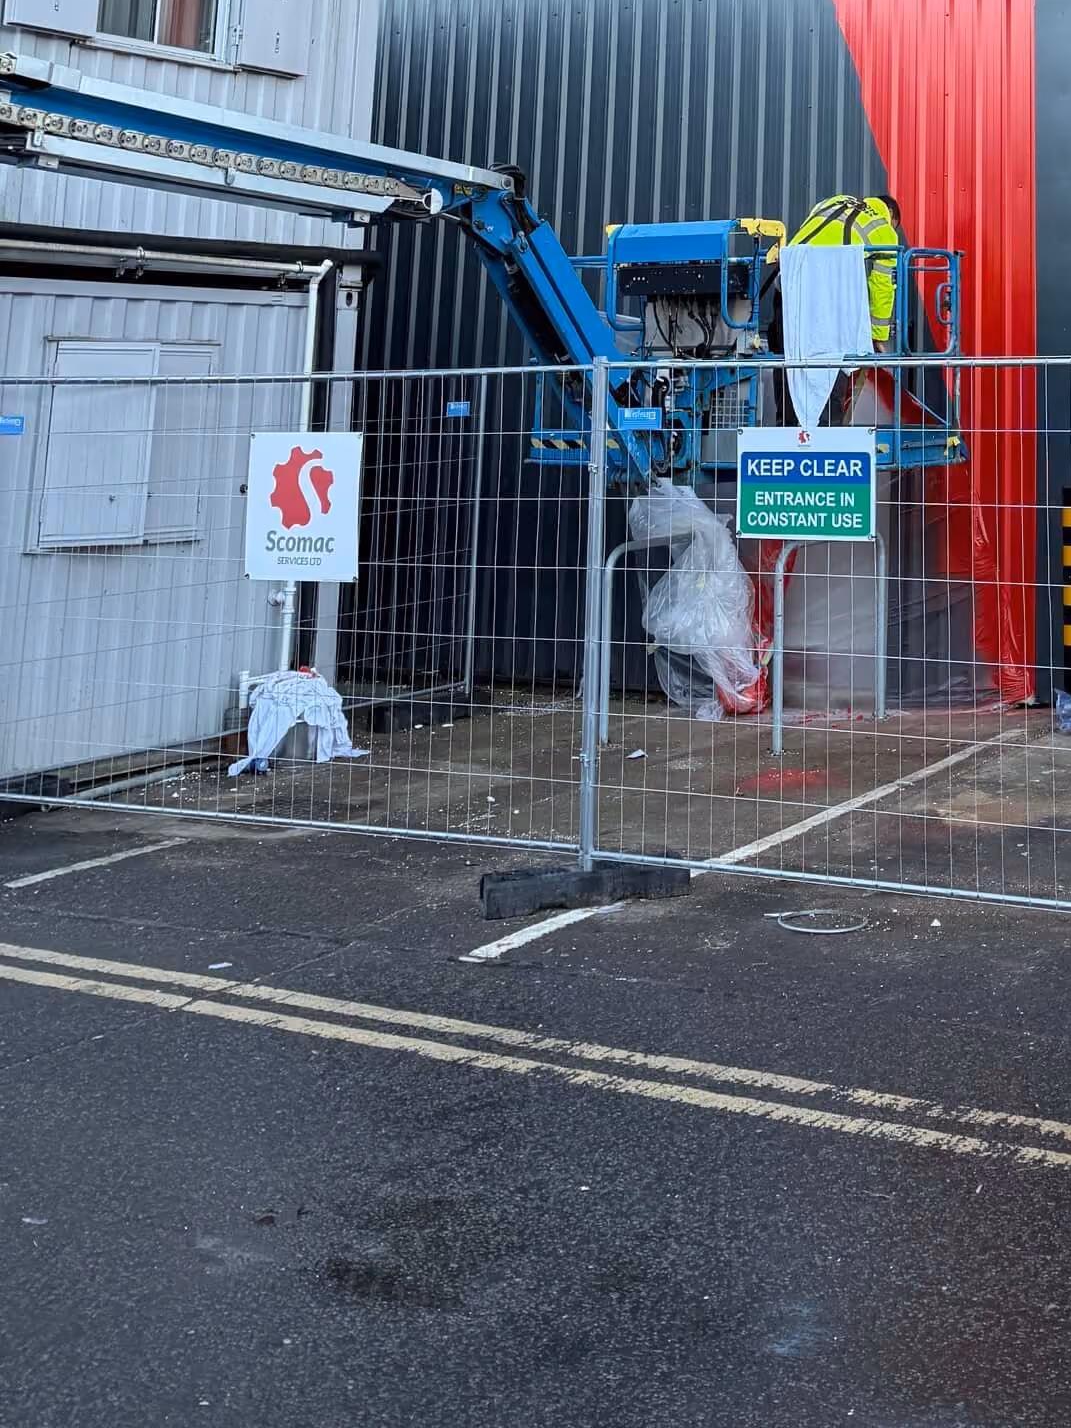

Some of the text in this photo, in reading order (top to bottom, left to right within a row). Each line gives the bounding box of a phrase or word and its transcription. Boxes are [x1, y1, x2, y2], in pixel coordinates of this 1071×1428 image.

[747, 459, 863, 477] KEEP CLEAR
[755, 491, 855, 507] ENTRANCE IN
[747, 511, 863, 528] CONSTANT USE
[265, 530, 335, 553] Scomac
[277, 556, 322, 566] SERVICES LTD
